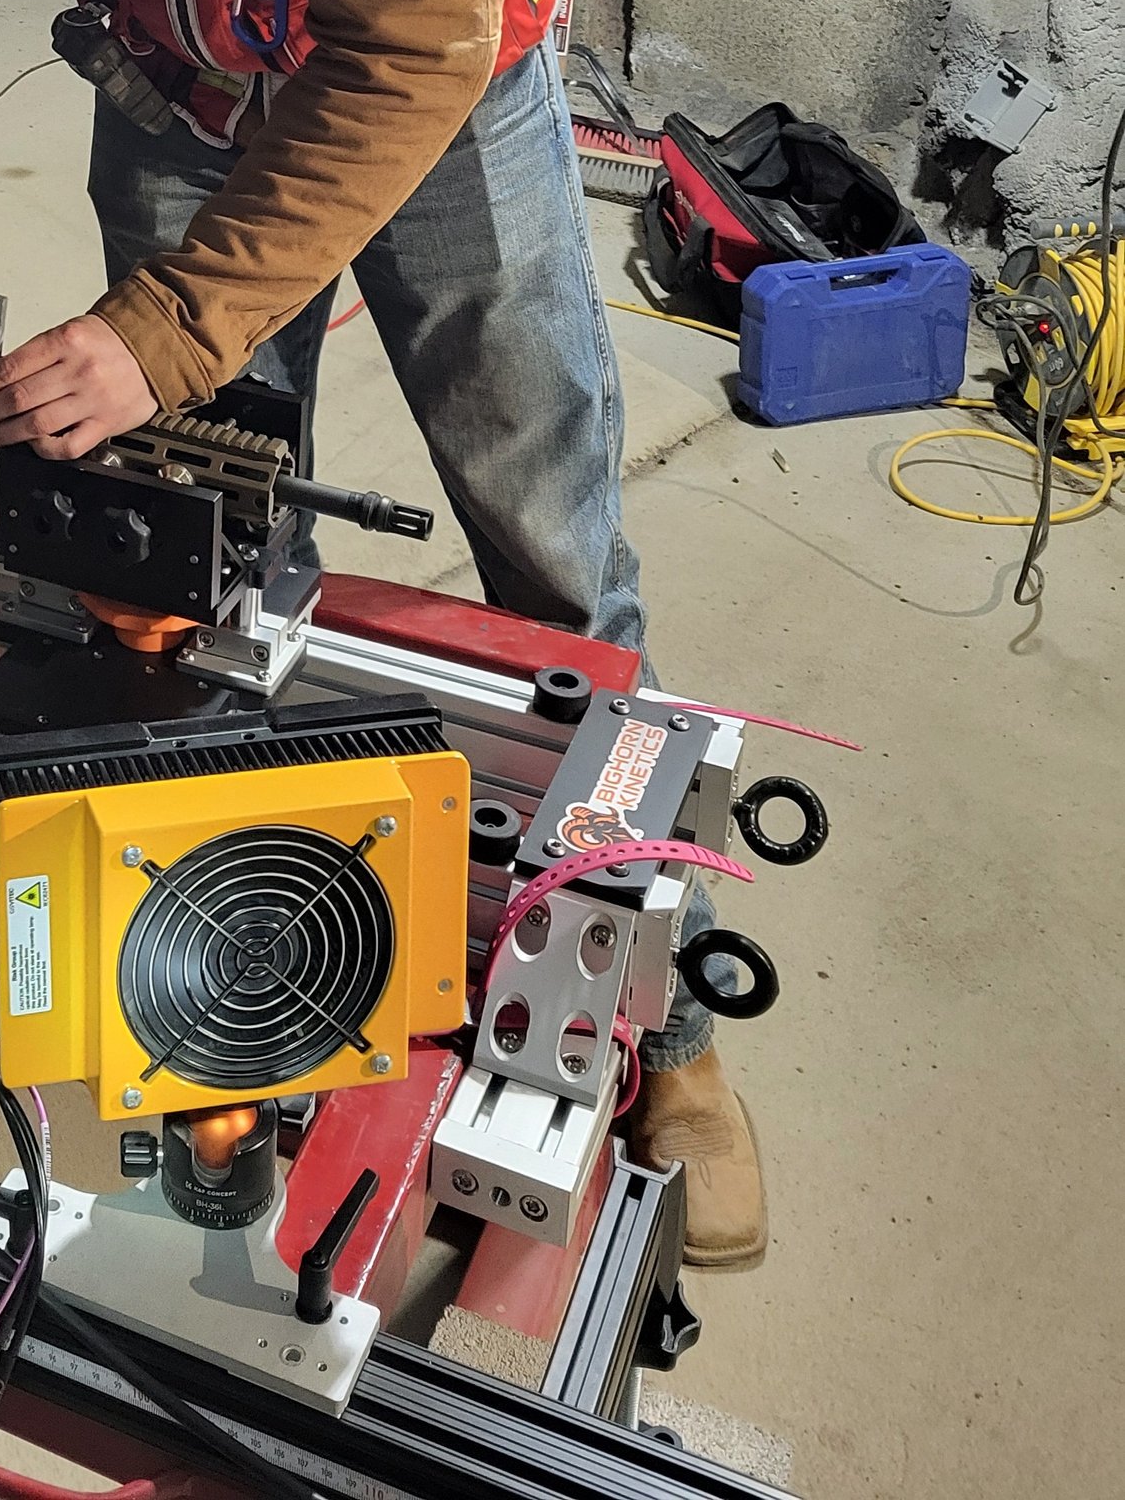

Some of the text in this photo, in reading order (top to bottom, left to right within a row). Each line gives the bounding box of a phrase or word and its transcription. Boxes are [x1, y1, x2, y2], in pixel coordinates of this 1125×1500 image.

[596, 721, 645, 803] BIGHORN
[617, 728, 664, 808] KINETICS
[207, 1189, 237, 1197] CONCEPT
[132, 1388, 150, 1404] 100
[364, 1484, 384, 1500] 110
